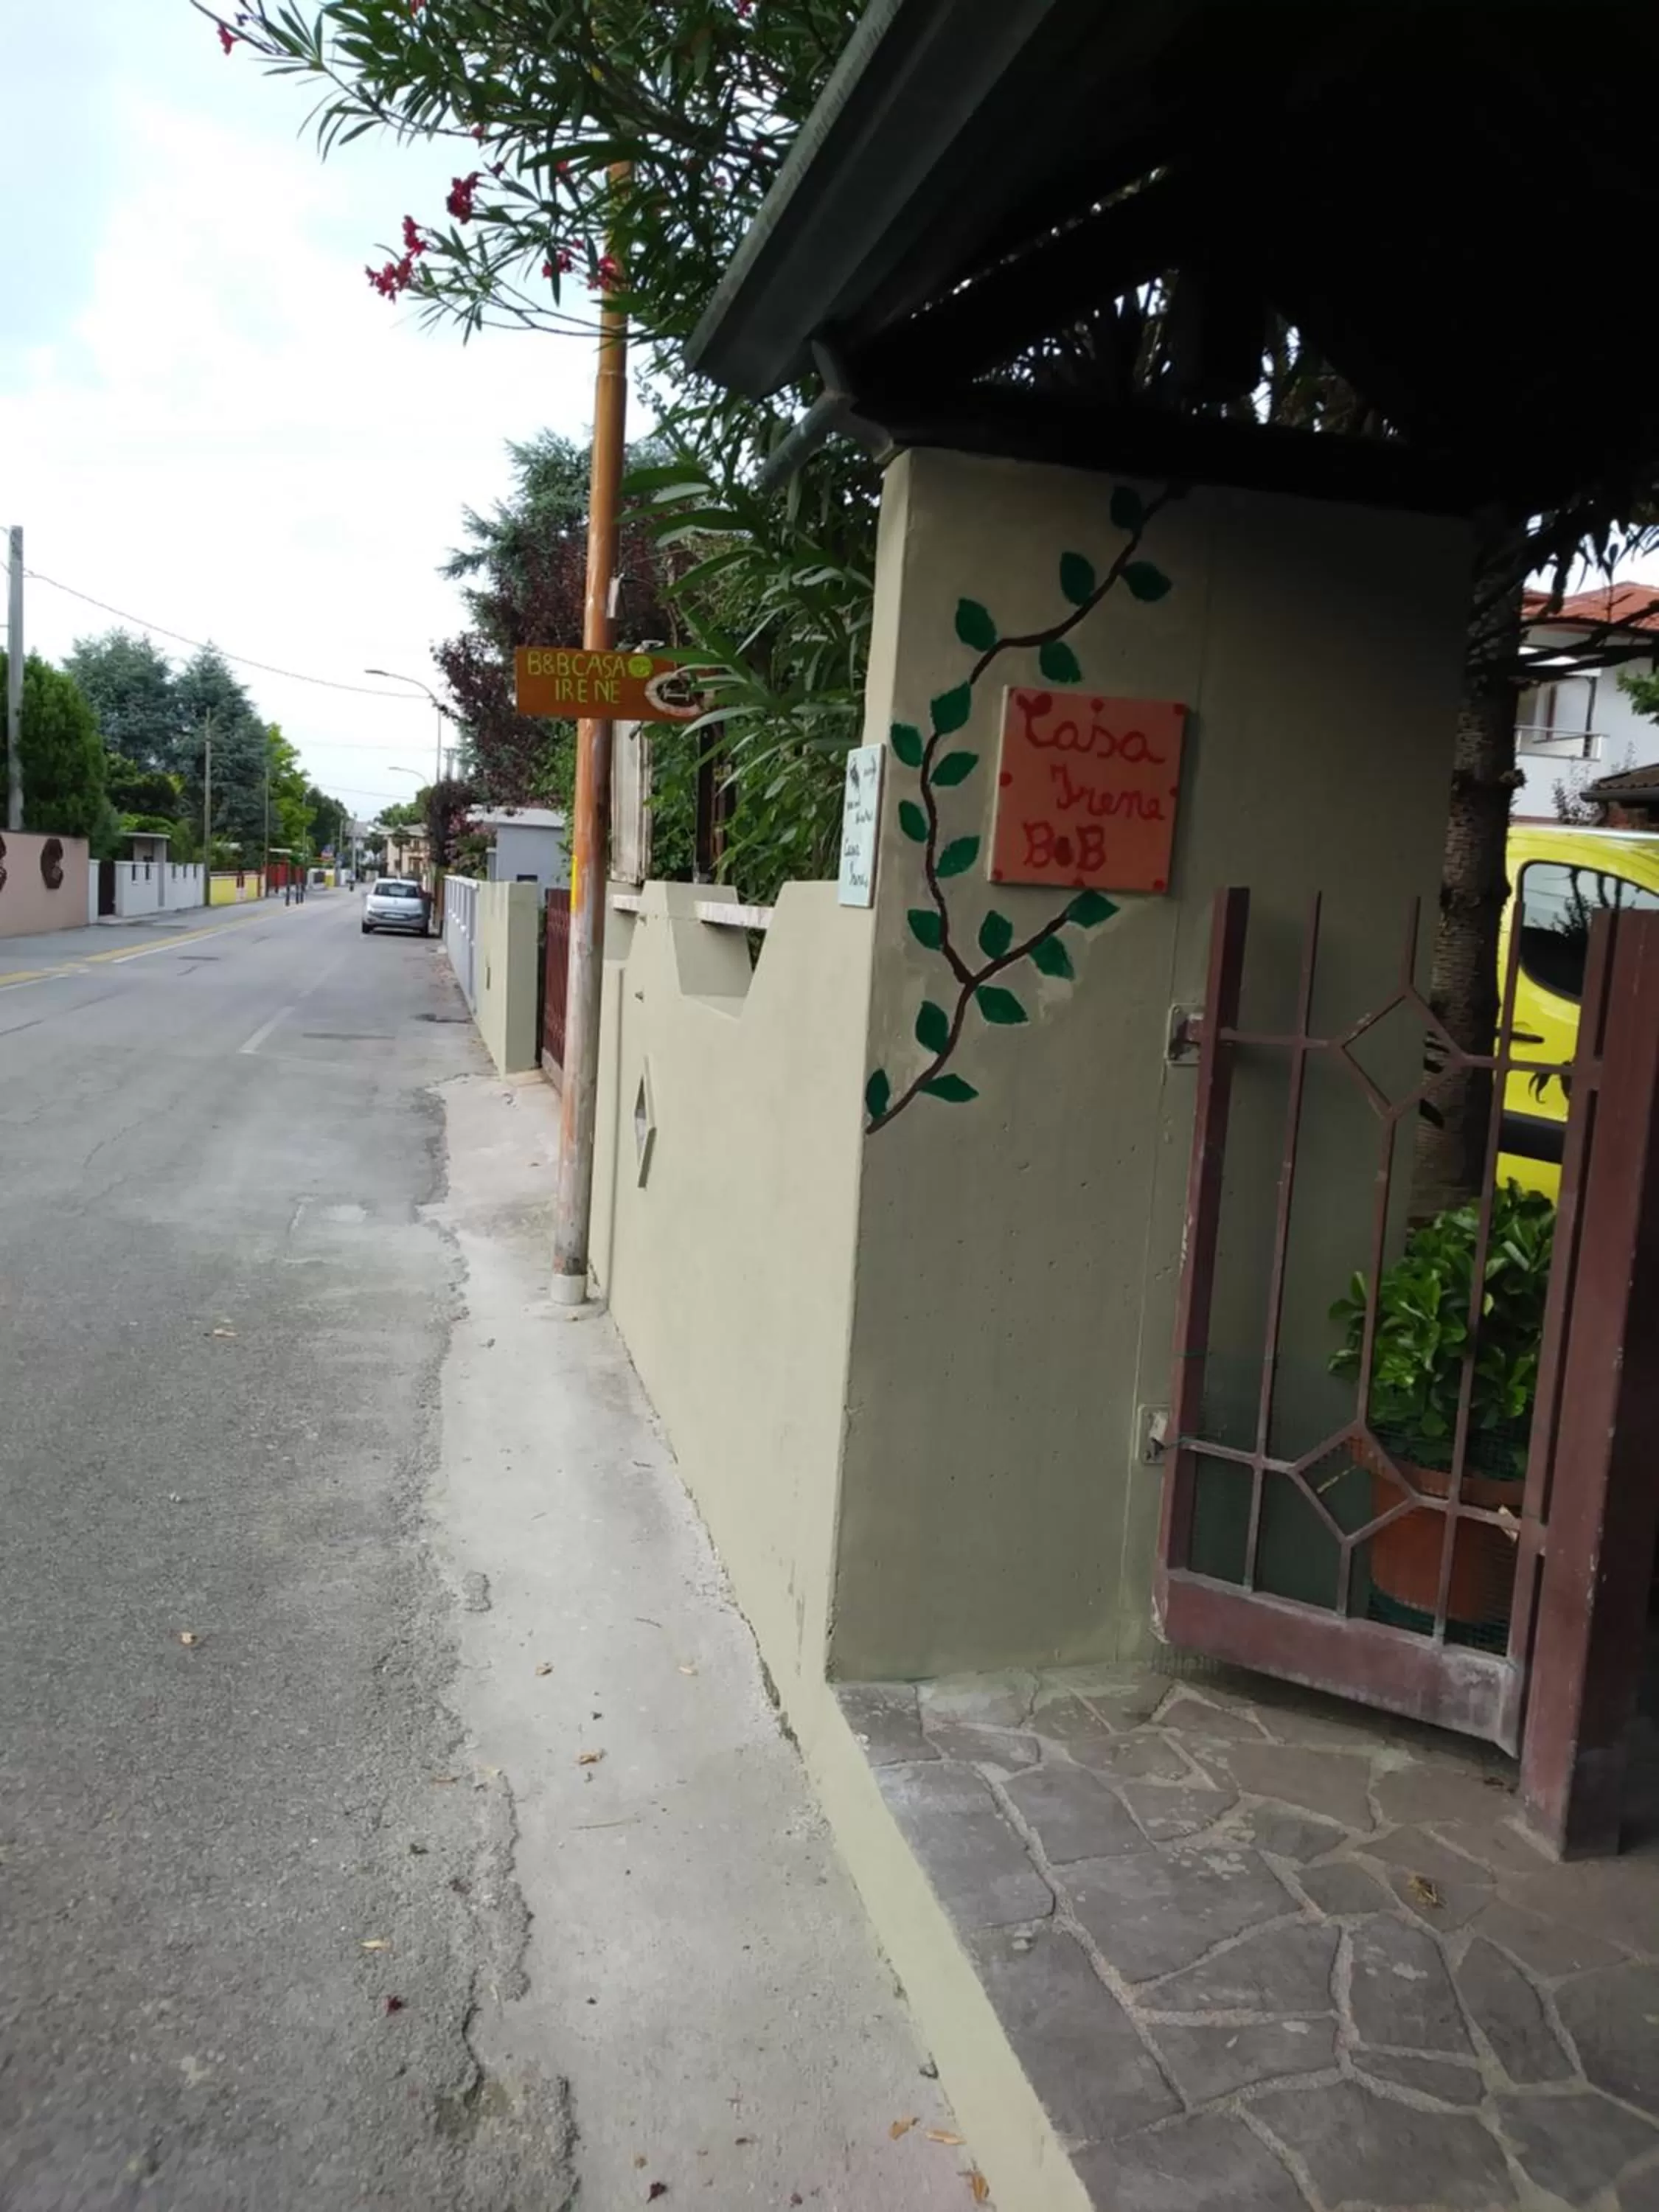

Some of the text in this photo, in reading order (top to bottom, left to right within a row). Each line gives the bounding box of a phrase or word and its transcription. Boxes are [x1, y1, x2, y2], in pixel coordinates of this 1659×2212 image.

[555, 678, 621, 704] IRENE
[1016, 693, 1166, 764] Casa
[1050, 763, 1166, 820] Irene
